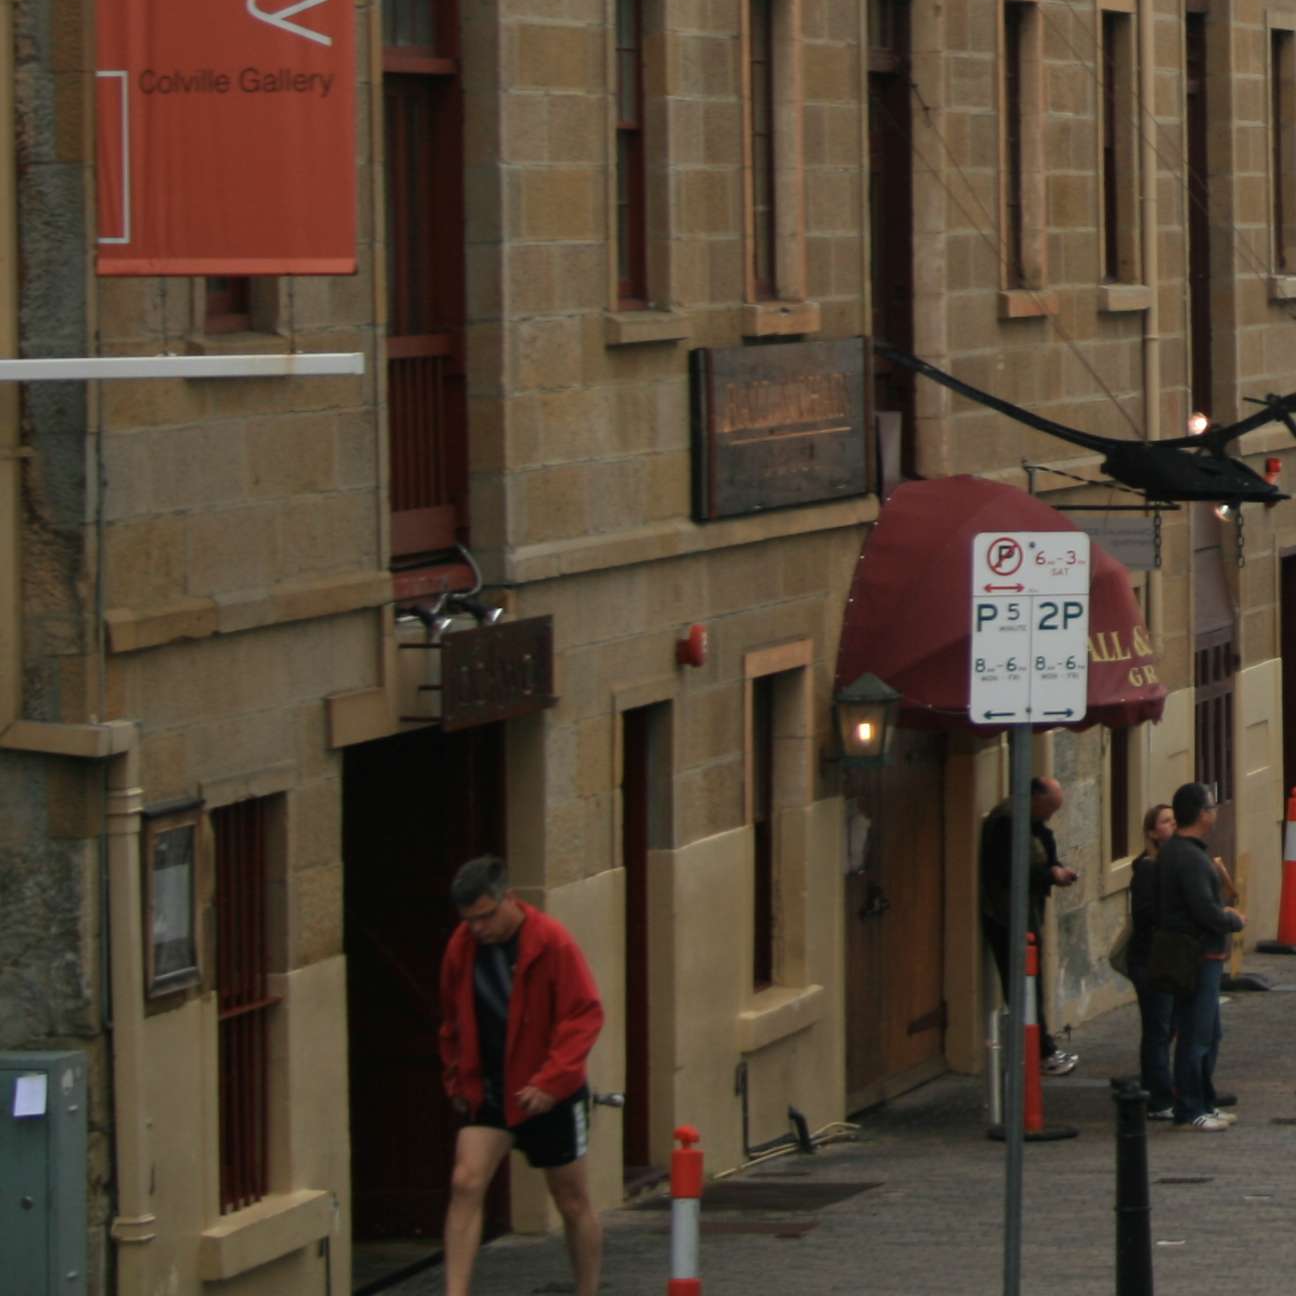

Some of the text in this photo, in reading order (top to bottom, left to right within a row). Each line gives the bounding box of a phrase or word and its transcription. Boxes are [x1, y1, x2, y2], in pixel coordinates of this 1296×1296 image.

[138, 65, 335, 97] Colville Gallery
[1051, 567, 1070, 577] SAT
[976, 603, 1020, 632] P 5
[1038, 601, 1084, 630] 2P
